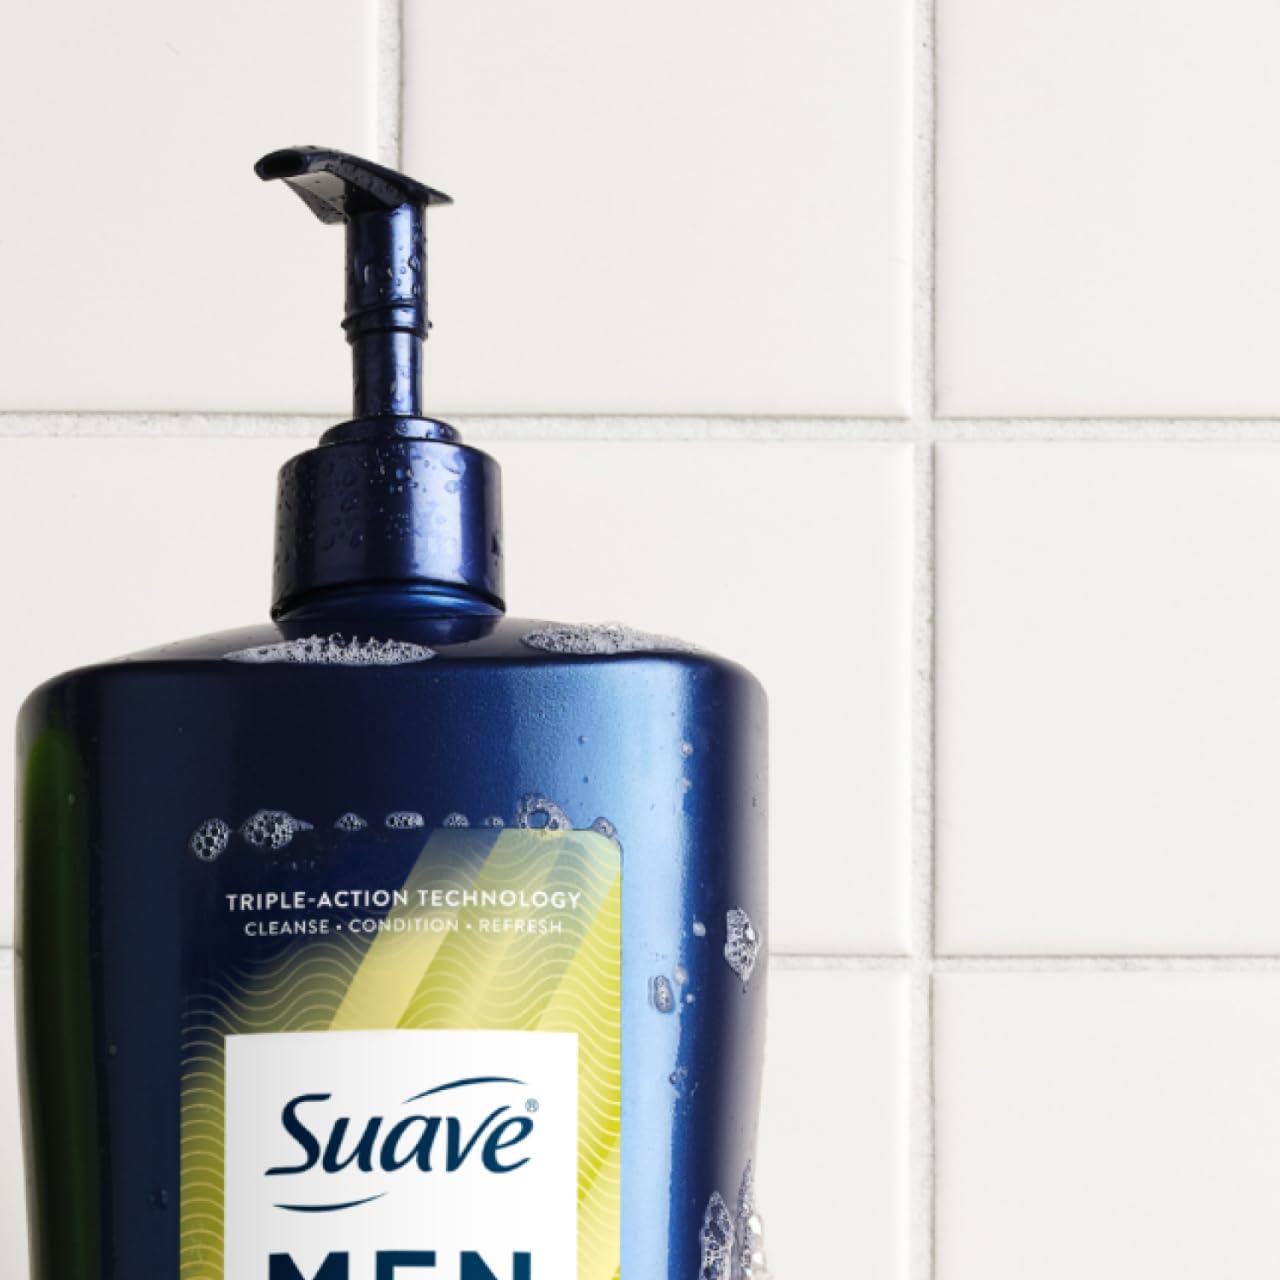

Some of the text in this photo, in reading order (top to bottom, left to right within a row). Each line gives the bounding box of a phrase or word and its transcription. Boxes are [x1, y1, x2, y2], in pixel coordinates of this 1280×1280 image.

[226, 889, 582, 911] TRIPLE-ACTION TECHNOLOGY
[244, 918, 563, 936] CLEANSE CONDITION REFRESH
